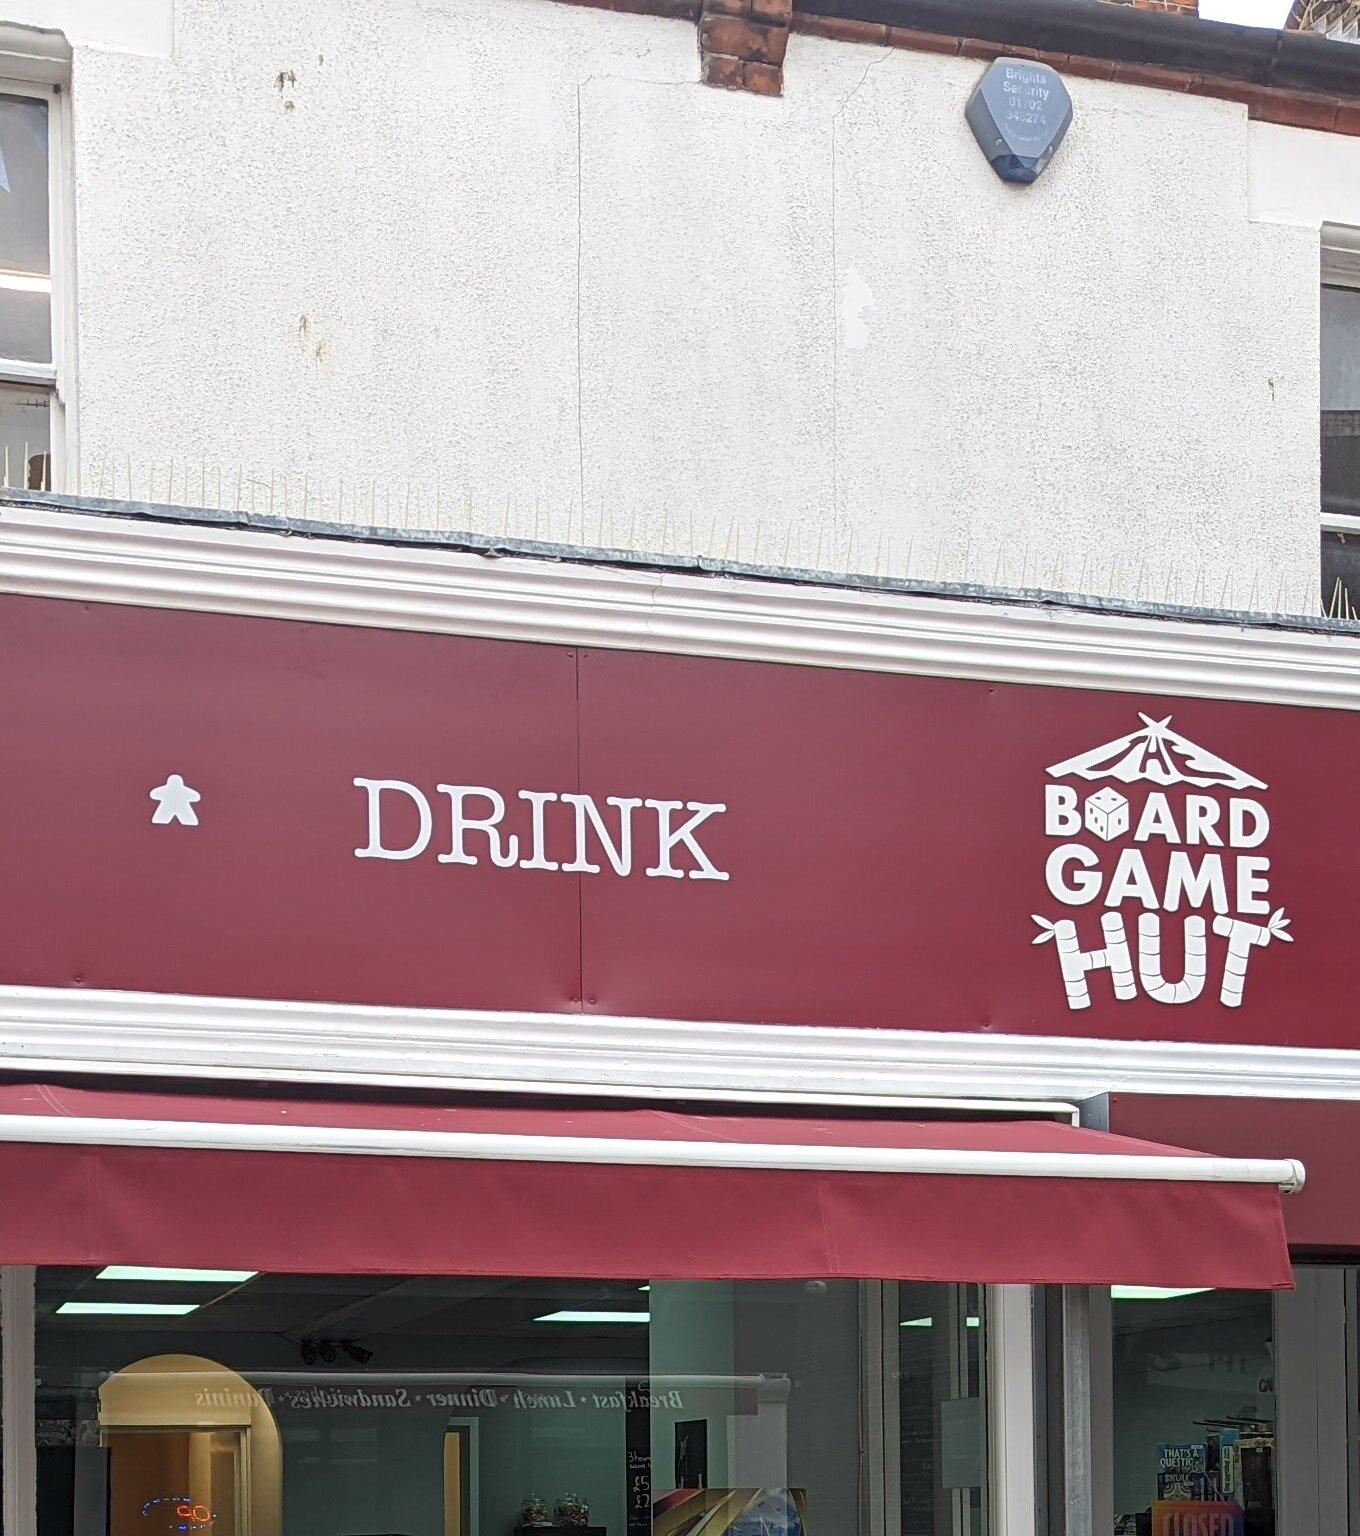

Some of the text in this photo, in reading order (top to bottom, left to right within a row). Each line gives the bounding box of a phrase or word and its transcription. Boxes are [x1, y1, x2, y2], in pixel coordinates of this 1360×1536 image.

[353, 778, 729, 880] DRINK
[1045, 785, 1269, 847] BOARD
[1046, 844, 1270, 914] GAME
[1054, 910, 1272, 1009] HUT
